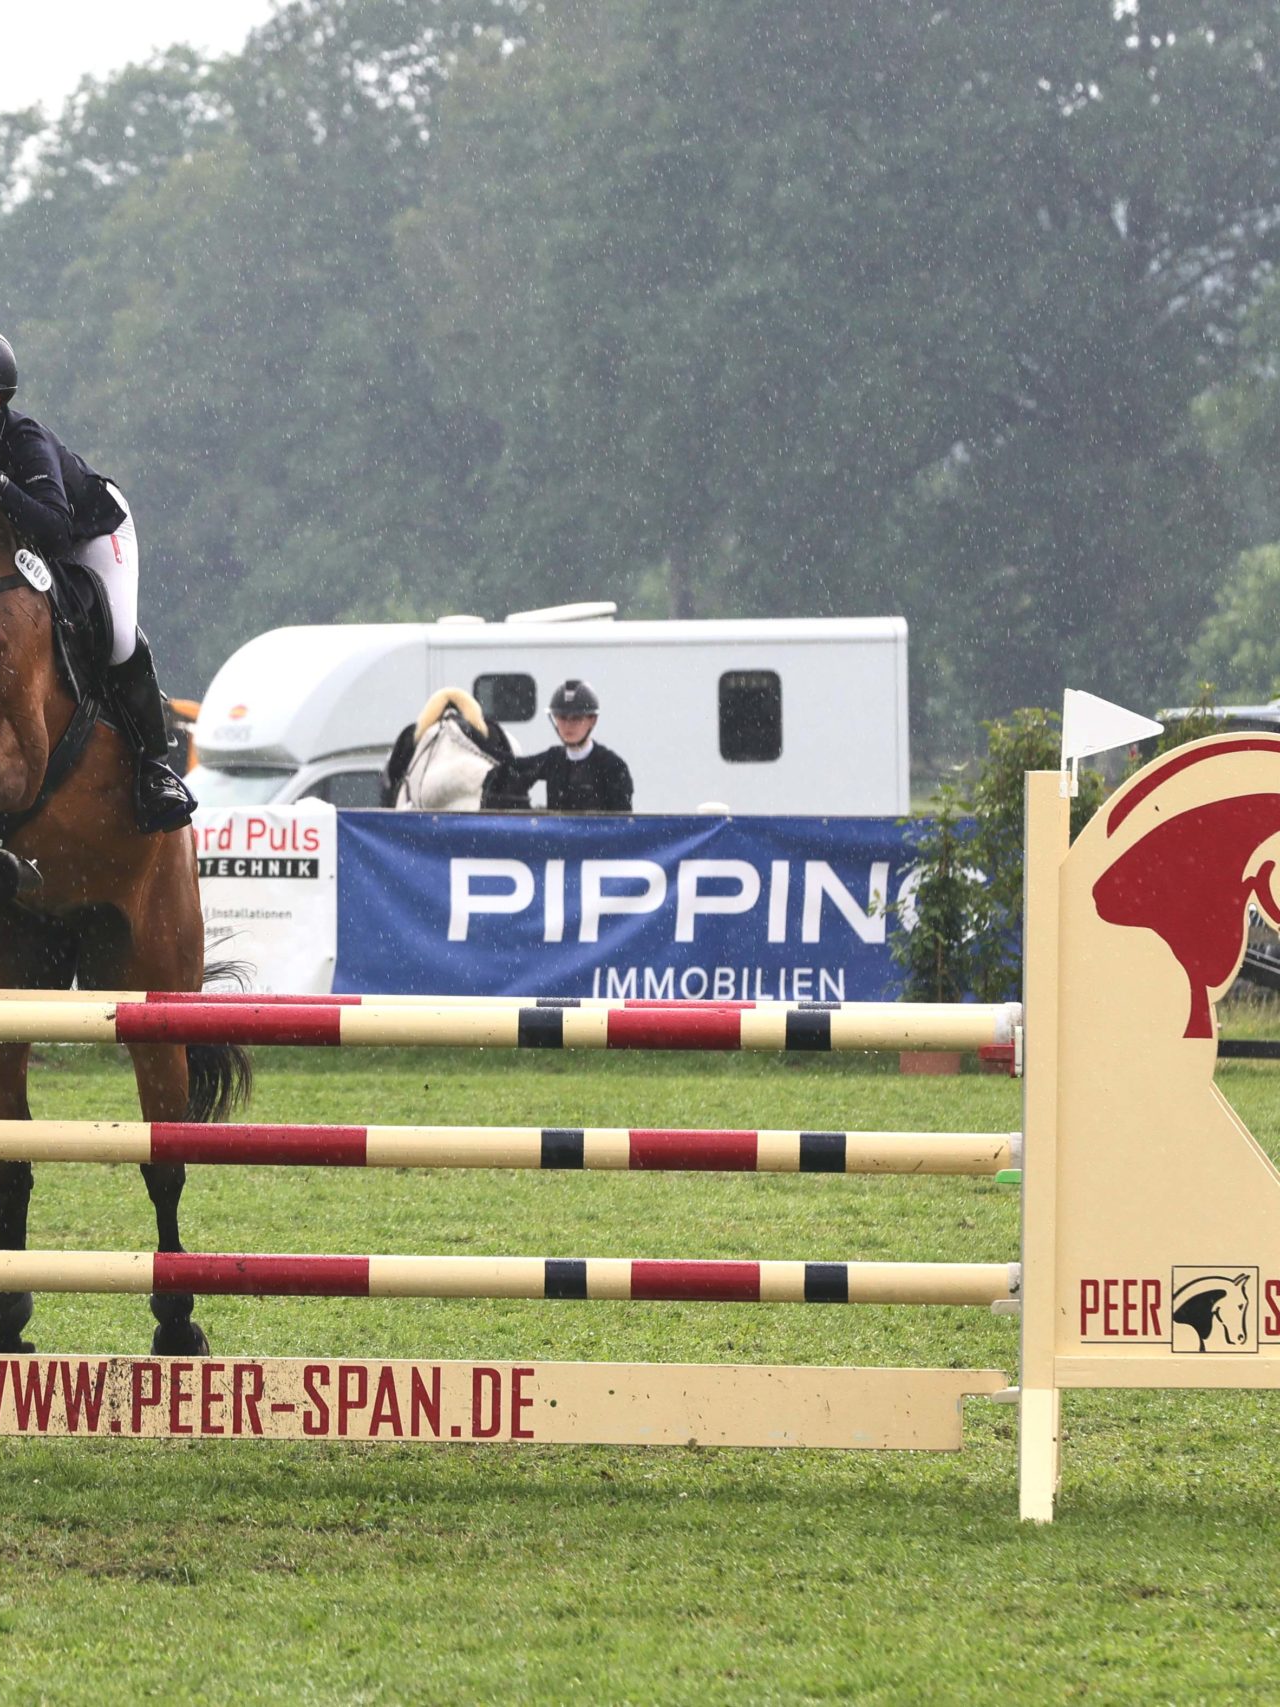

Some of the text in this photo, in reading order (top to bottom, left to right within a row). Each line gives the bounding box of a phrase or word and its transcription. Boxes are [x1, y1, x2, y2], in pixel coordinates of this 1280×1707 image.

[246, 818, 320, 851] Puls
[198, 859, 311, 876] TECHNIK
[211, 906, 293, 919] Installationen
[592, 966, 846, 1001] IMMOBILIEN
[1080, 1279, 1162, 1336] PEER
